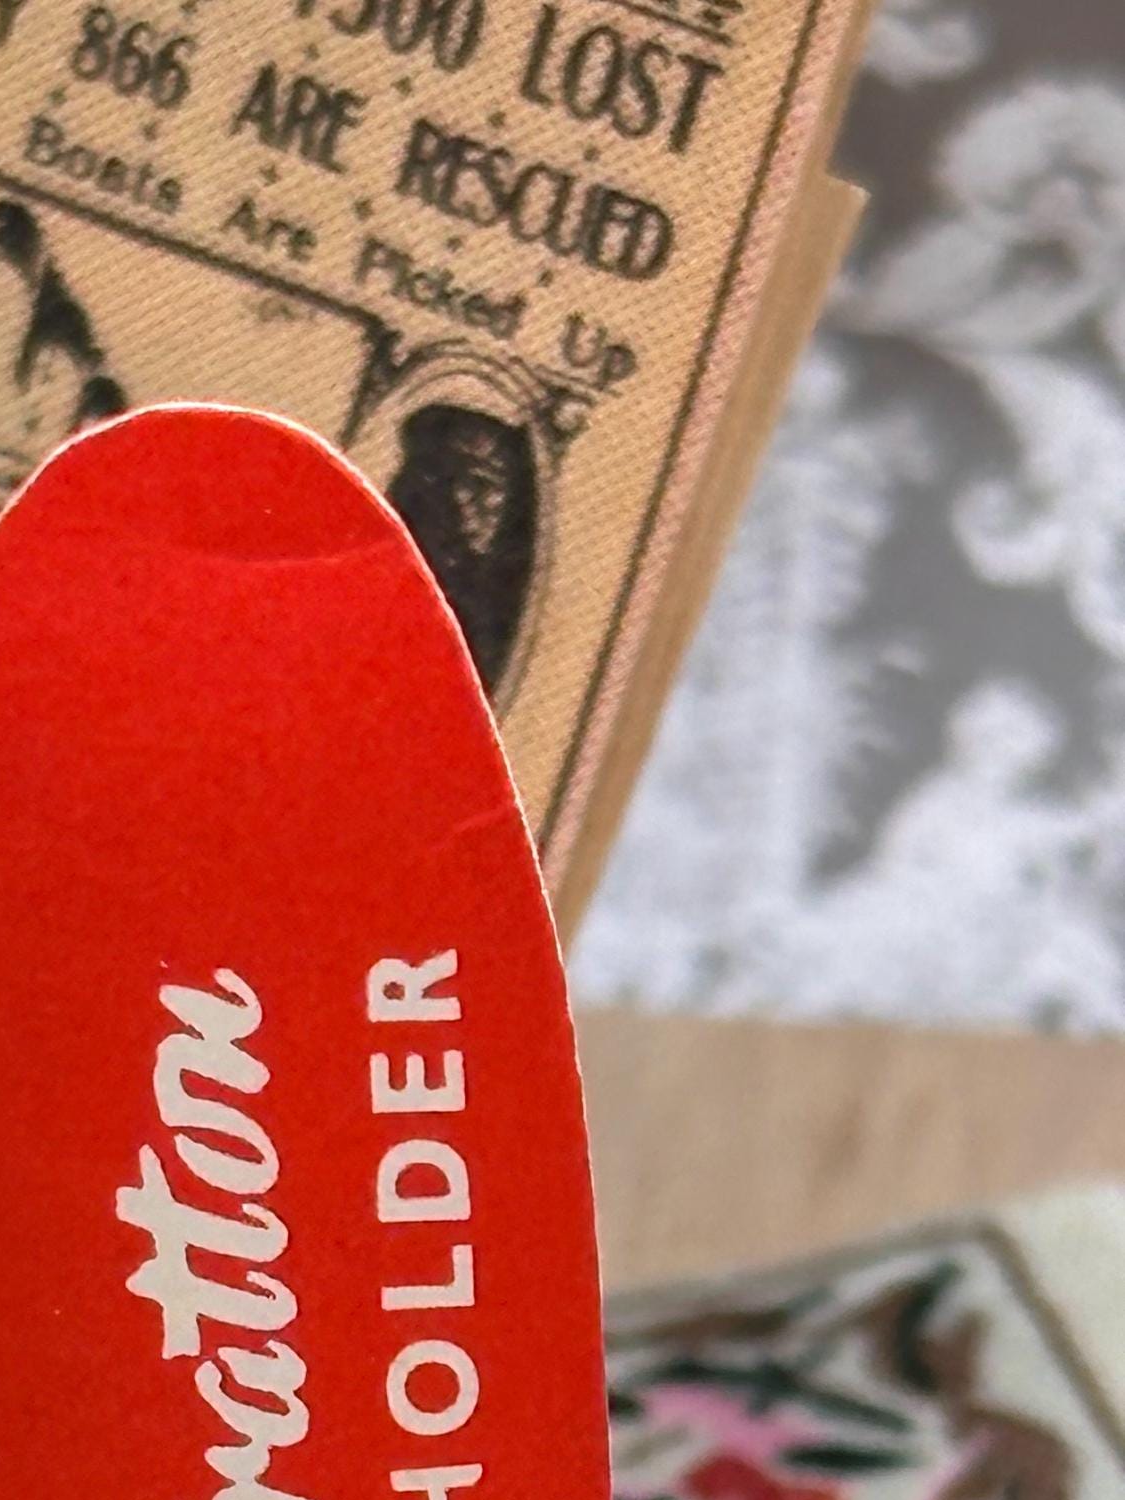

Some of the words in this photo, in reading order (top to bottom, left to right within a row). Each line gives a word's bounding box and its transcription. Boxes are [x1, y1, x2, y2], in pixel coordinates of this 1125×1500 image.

[72, 5, 194, 108] 866
[231, 61, 371, 174] ARE
[394, 117, 674, 281] RESCUED
[293, 0, 484, 73] 00
[520, 2, 725, 154] LOST
[222, 199, 318, 262] Are
[355, 236, 528, 339] Picked
[561, 311, 639, 392] Up
